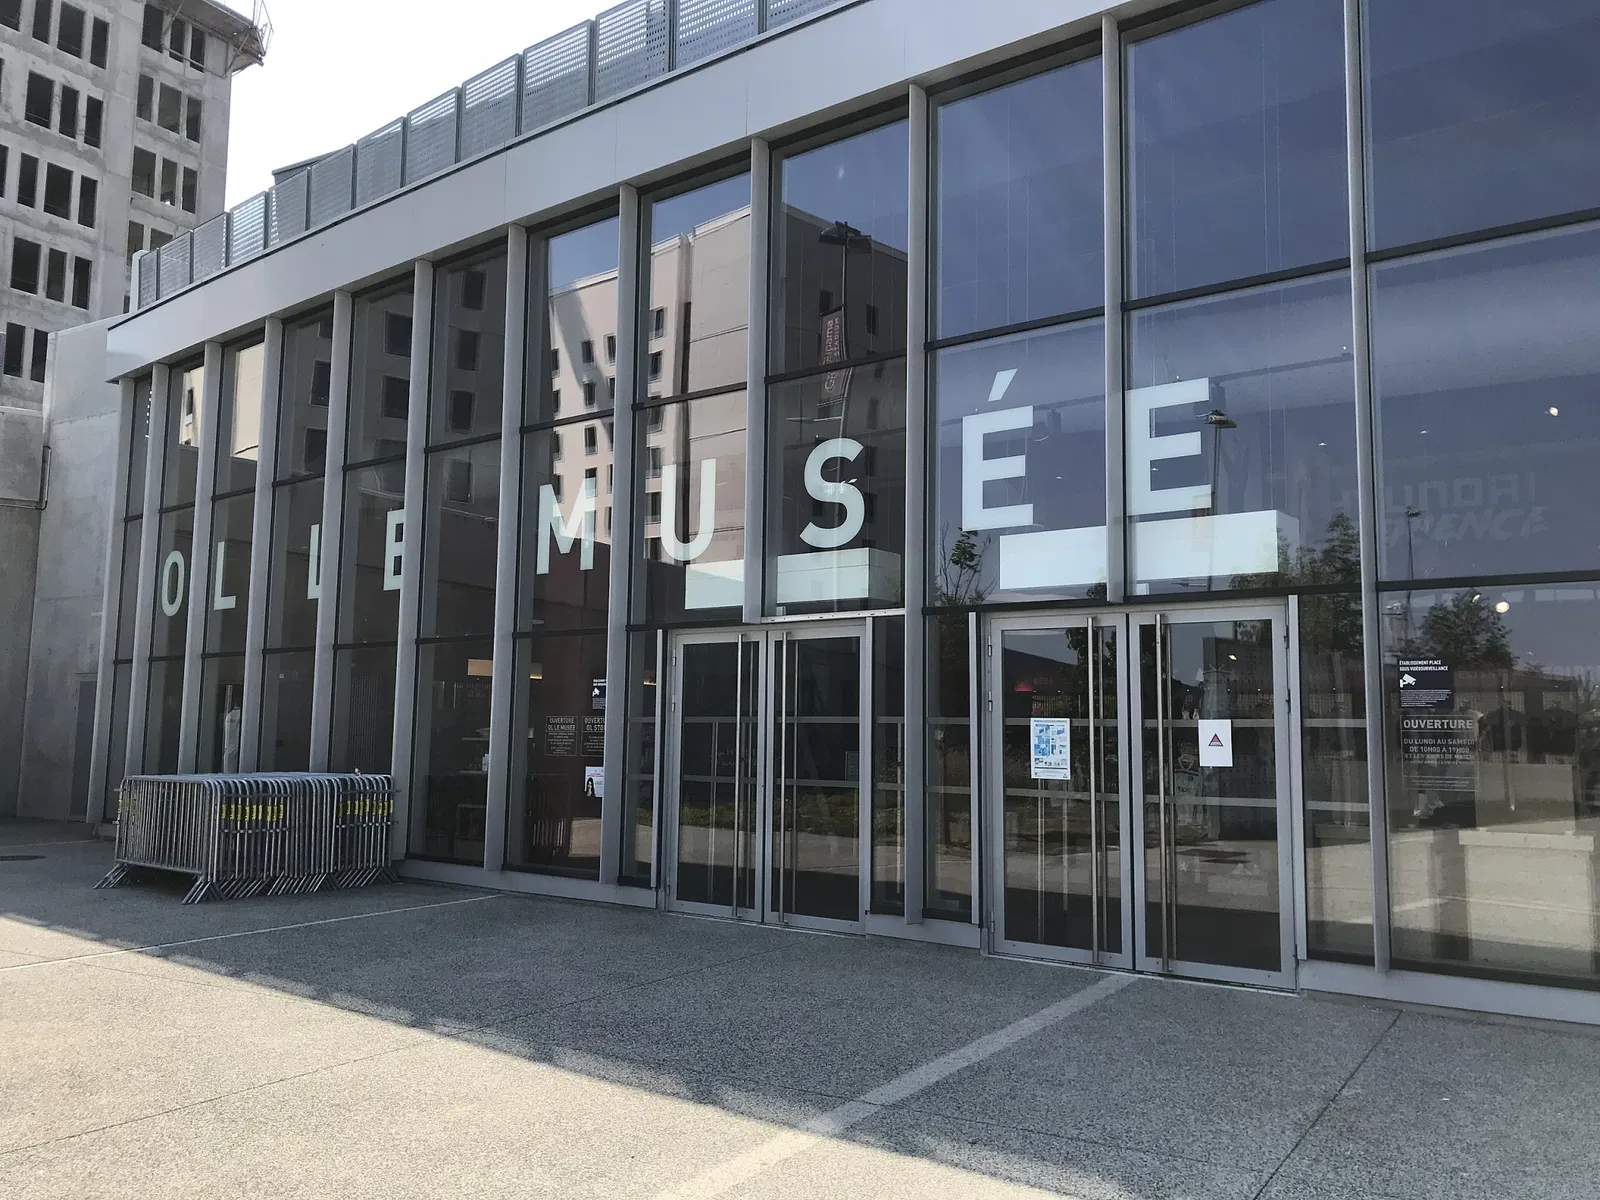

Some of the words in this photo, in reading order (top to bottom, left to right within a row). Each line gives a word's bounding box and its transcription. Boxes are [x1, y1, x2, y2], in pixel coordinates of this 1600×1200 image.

[161, 541, 237, 617] OL
[536, 369, 1212, 575] MUSÉE
[1403, 719, 1474, 729] OUVERTURE
